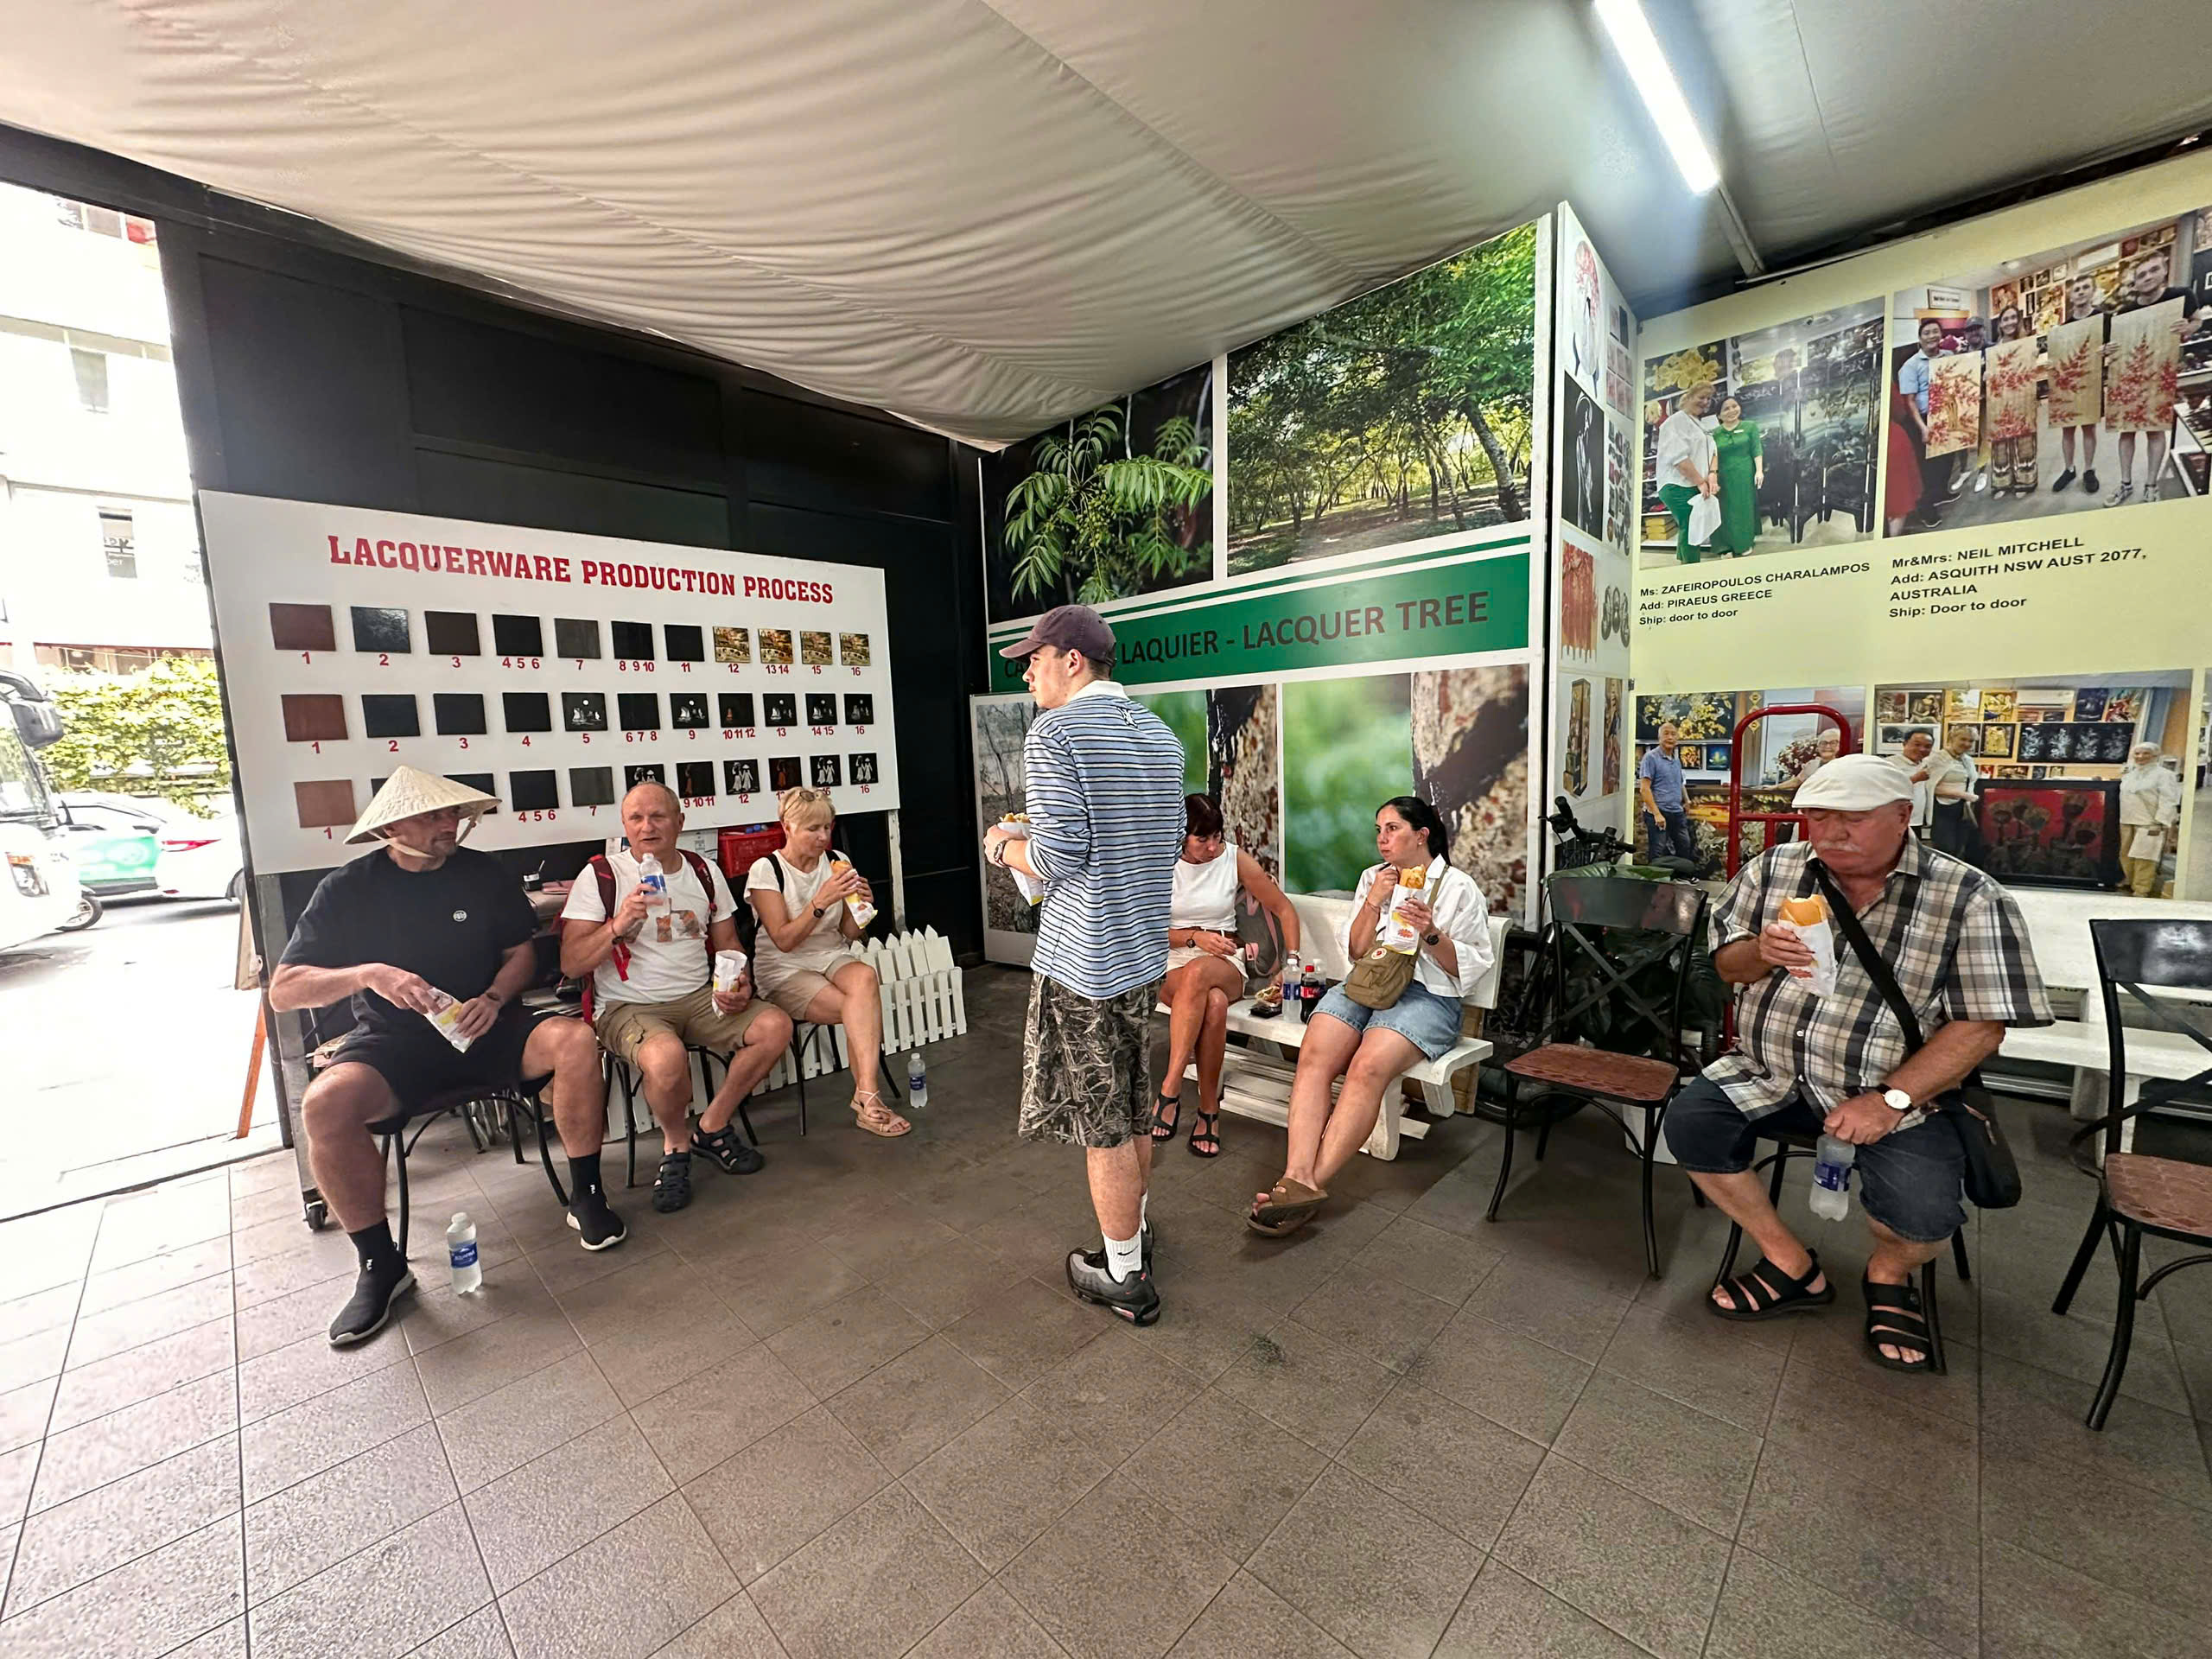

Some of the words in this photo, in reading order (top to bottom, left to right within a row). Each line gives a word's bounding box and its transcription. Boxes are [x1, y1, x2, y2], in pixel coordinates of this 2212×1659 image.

[1892, 553, 1952, 569] Mr&Mrs:
[1957, 548, 1993, 561] NEIL
[1998, 537, 2085, 556] MITCHELL
[327, 535, 571, 584] LACQUERWARE
[581, 560, 735, 596] PRODUCTION
[744, 576, 834, 605] PROCESS
[1891, 574, 1924, 585] Add:
[1928, 565, 1999, 582] ASQUITH
[2004, 559, 2044, 573] NSW
[2046, 553, 2096, 569] AUST
[2100, 548, 2147, 563] 2077,
[1641, 588, 1658, 597] Ms:
[1661, 575, 1763, 595] ZAFEIROPOULOS
[1765, 562, 1871, 583] CHARALAMPOS
[1890, 584, 1978, 601] AUSTRALIA
[1640, 601, 1664, 612] Add:
[1667, 595, 1718, 609] PIRAEUS
[1721, 589, 1773, 603] GREECE
[1889, 606, 1926, 618] Ship:
[1930, 604, 1967, 614] Door
[1970, 601, 1986, 611] to
[1990, 598, 2027, 609] door
[1639, 616, 1667, 627] Ship:
[1669, 613, 1694, 623] door
[1697, 612, 1709, 620] to
[1711, 608, 1738, 619] door
[1122, 630, 1219, 664] LAQUIER
[1244, 604, 1386, 650] LACQUER
[1396, 591, 1490, 630] TREE
[302, 652, 312, 664] 1
[379, 653, 389, 667] 2
[451, 657, 461, 669] 3
[502, 657, 512, 668] 4
[518, 658, 526, 669] 5
[531, 658, 540, 669] 6
[576, 660, 584, 671] 7
[619, 661, 626, 671] 8
[632, 661, 640, 671] 9
[643, 661, 655, 672] 10
[681, 663, 691, 672] 11
[728, 663, 740, 673] 12
[766, 664, 777, 674] 13
[779, 664, 790, 674] 14
[811, 664, 822, 674] 15
[851, 666, 862, 677] 16
[689, 730, 696, 741] 9
[723, 729, 734, 740] 10
[734, 729, 743, 739] 11
[744, 728, 756, 739] 12
[776, 728, 786, 738] 13
[812, 727, 822, 737] 14
[823, 727, 834, 736] 15
[855, 726, 865, 735] 16
[459, 737, 468, 749] 3
[522, 736, 531, 747] 4
[582, 734, 590, 744] 5
[626, 733, 632, 743] 6
[638, 732, 645, 742] 7
[650, 731, 658, 741] 8
[311, 741, 321, 753] 1
[388, 739, 399, 753] 2
[860, 785, 870, 794] 16
[683, 798, 690, 808] 9
[693, 797, 704, 808] 10
[704, 797, 715, 806] 11
[738, 794, 749, 804] 12
[518, 811, 527, 823] 4
[533, 810, 543, 822] 5
[547, 810, 556, 821] 6
[589, 806, 597, 817] 7
[323, 827, 333, 840] 1
